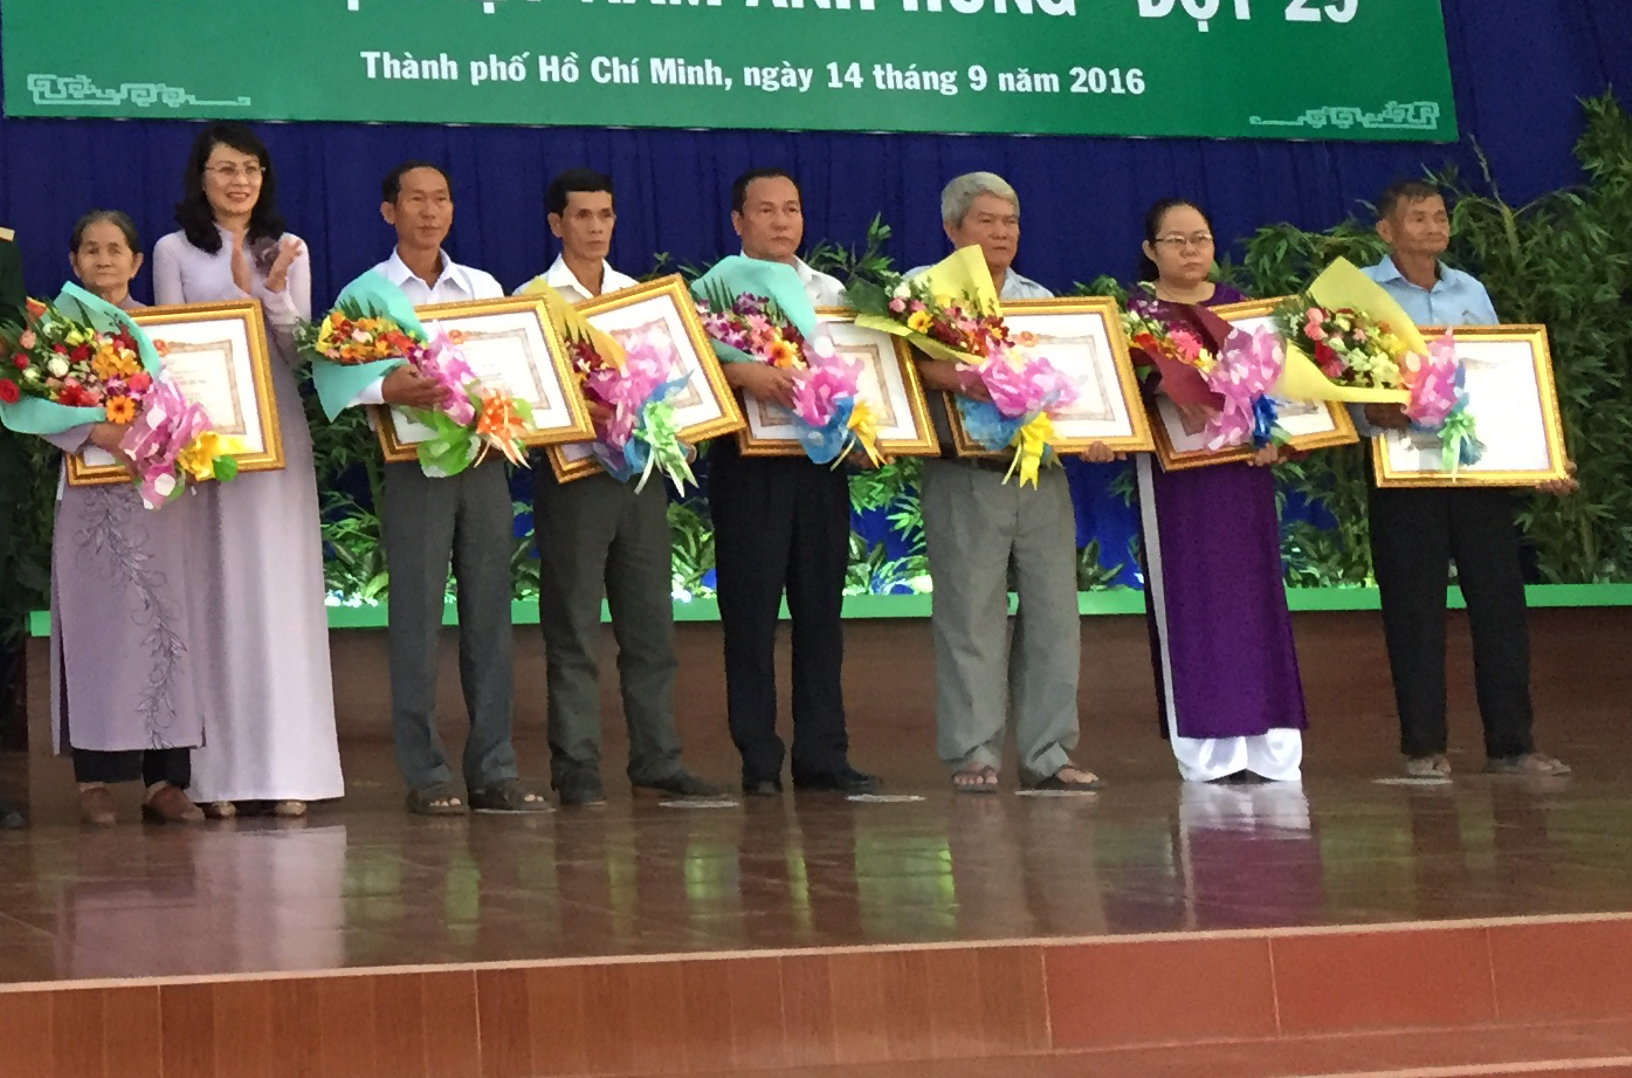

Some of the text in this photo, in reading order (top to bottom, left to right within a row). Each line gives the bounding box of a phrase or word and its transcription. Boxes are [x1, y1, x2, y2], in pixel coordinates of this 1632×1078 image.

[359, 51, 1146, 96] Thành phố Hồ Chí Minh, ngày 14 tháng 9 năm 2016
